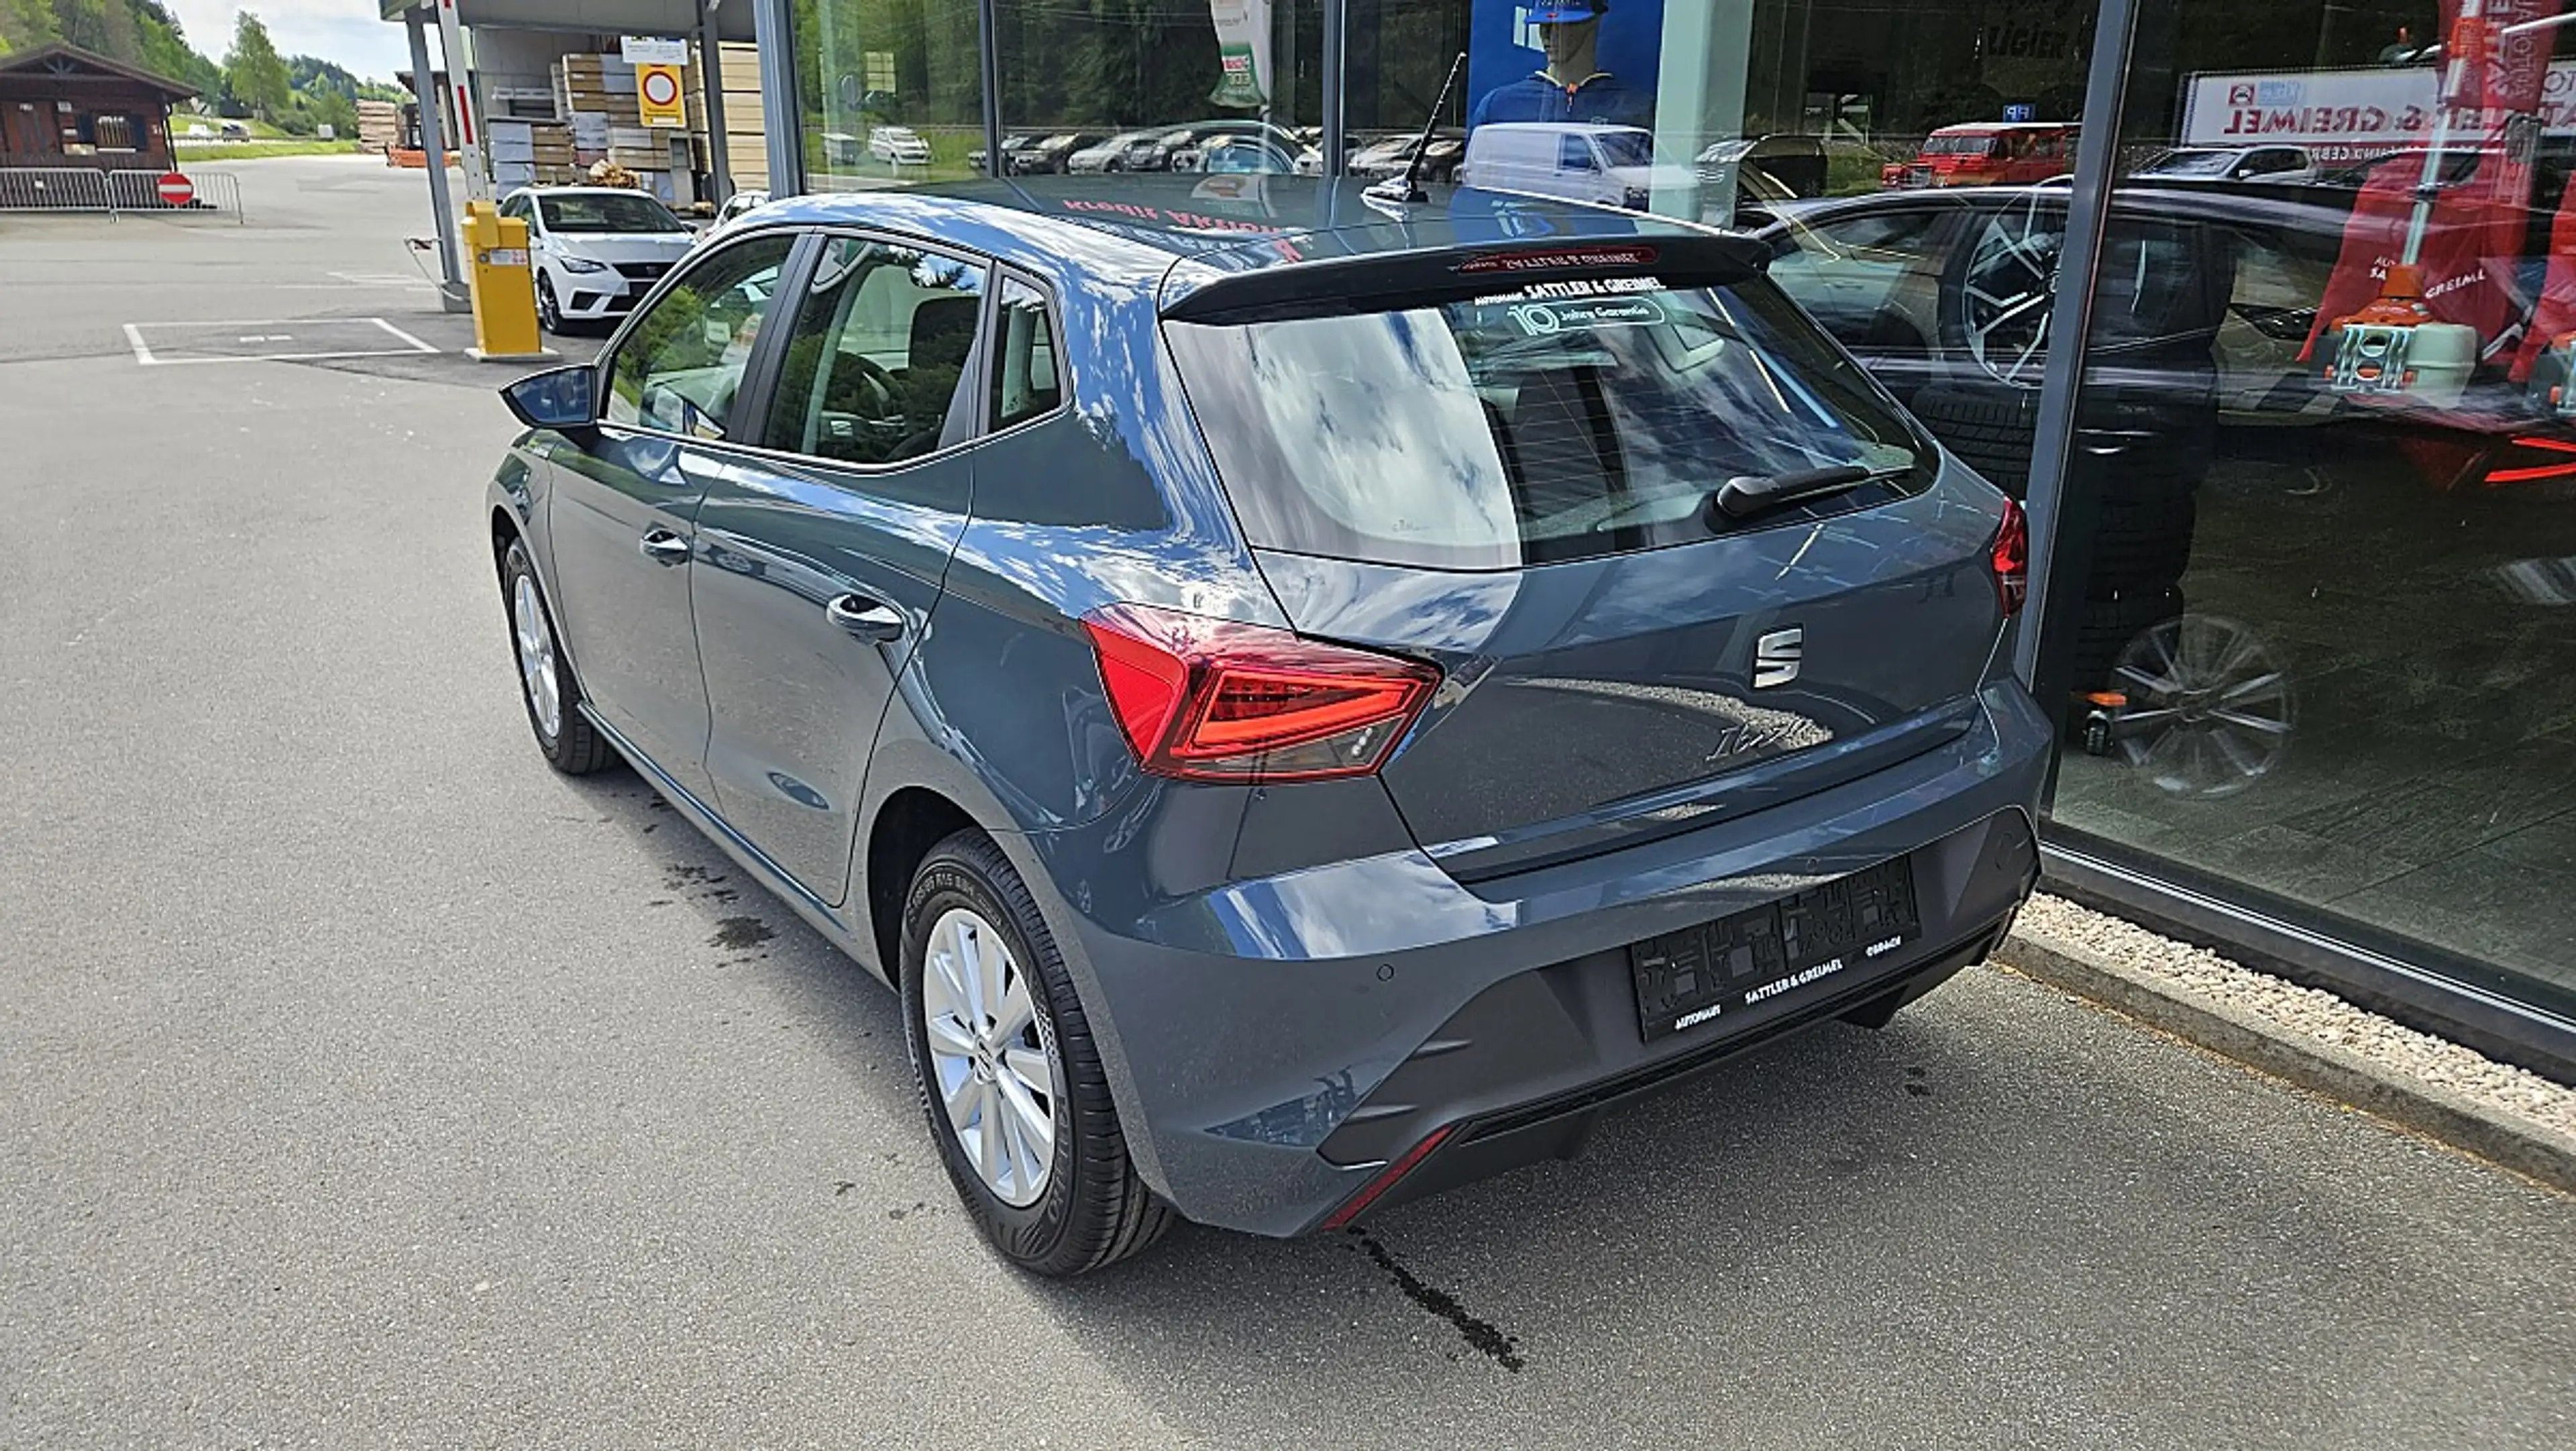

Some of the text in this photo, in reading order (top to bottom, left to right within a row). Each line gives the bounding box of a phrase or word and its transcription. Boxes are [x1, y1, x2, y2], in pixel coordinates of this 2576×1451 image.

[1523, 278, 1594, 299] SATTLER
[1603, 276, 1667, 292] GREIMEL
[1507, 304, 1560, 336] 10
[1745, 977, 1791, 1005] SATTLER
[1799, 958, 1843, 984] GREIMEL
